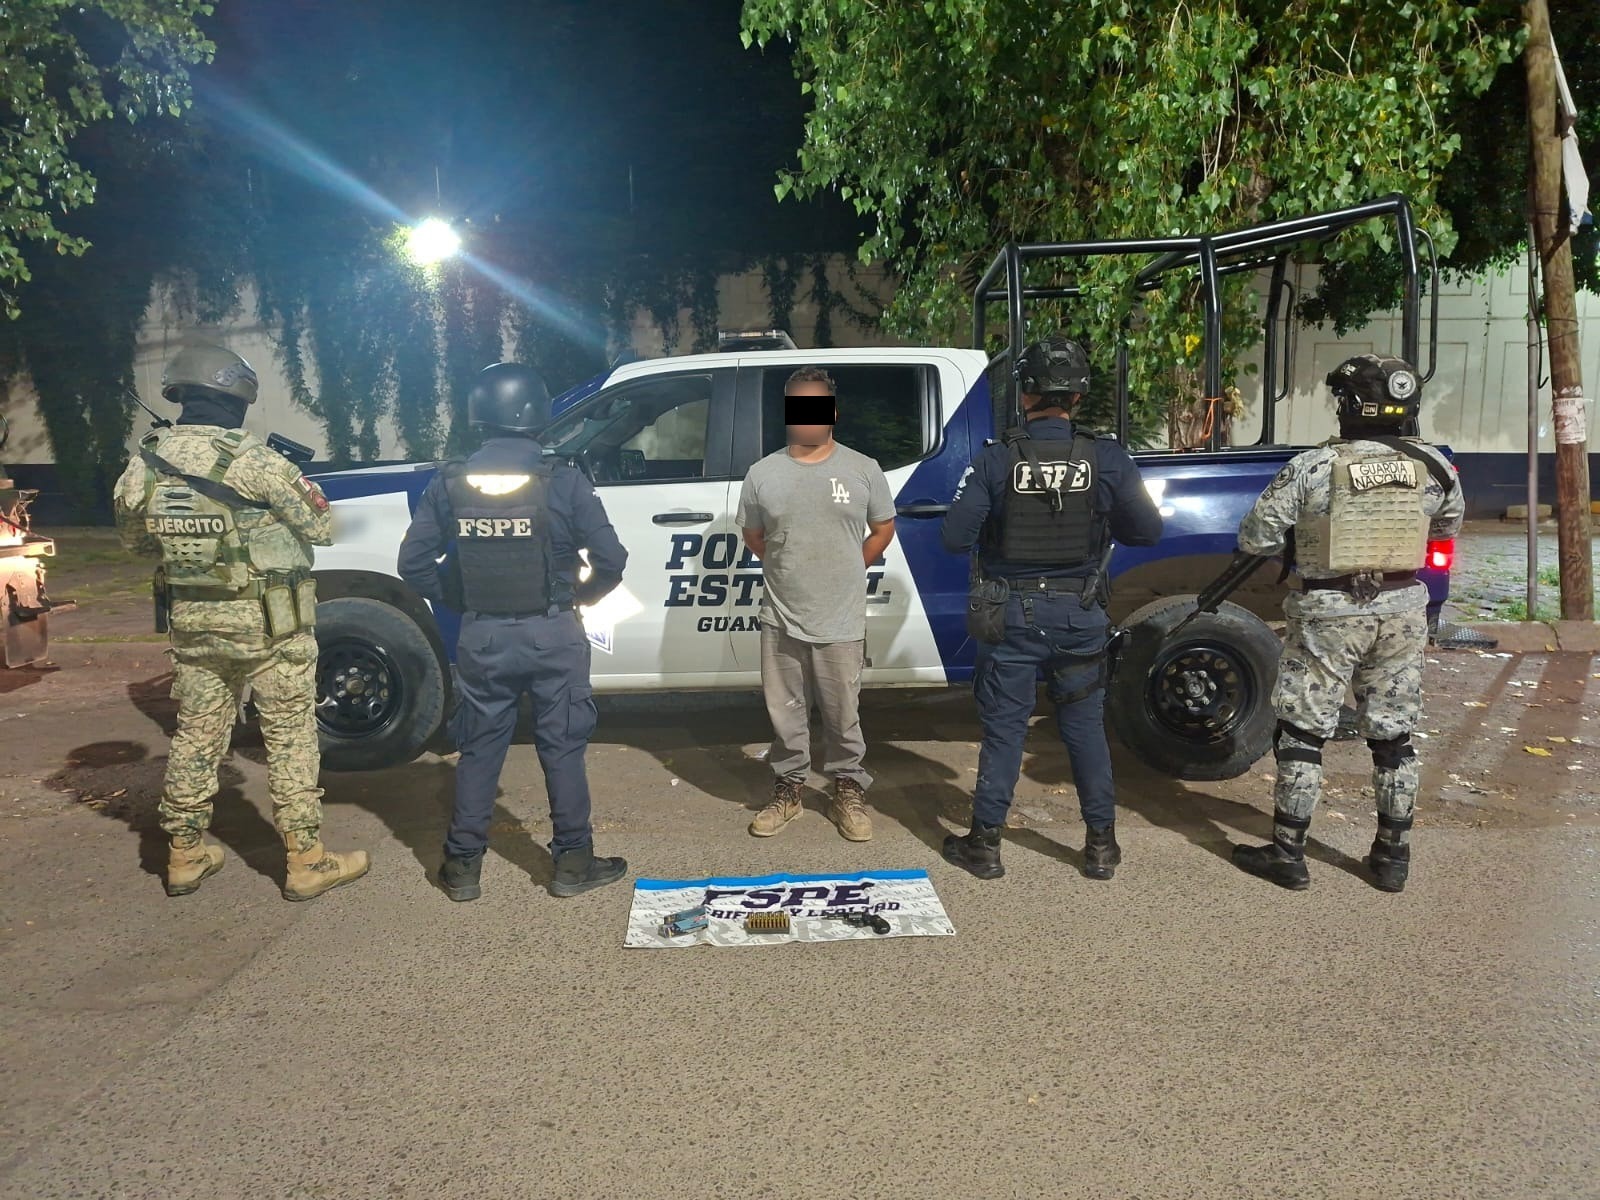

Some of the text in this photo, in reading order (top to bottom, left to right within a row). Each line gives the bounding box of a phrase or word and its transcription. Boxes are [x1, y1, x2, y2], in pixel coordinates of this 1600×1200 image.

[1359, 462, 1408, 476] GUARDIA
[830, 477, 850, 504] LA
[145, 516, 225, 534] EJÉRCITO
[457, 518, 532, 537] FSPE
[790, 908, 803, 917] Y
